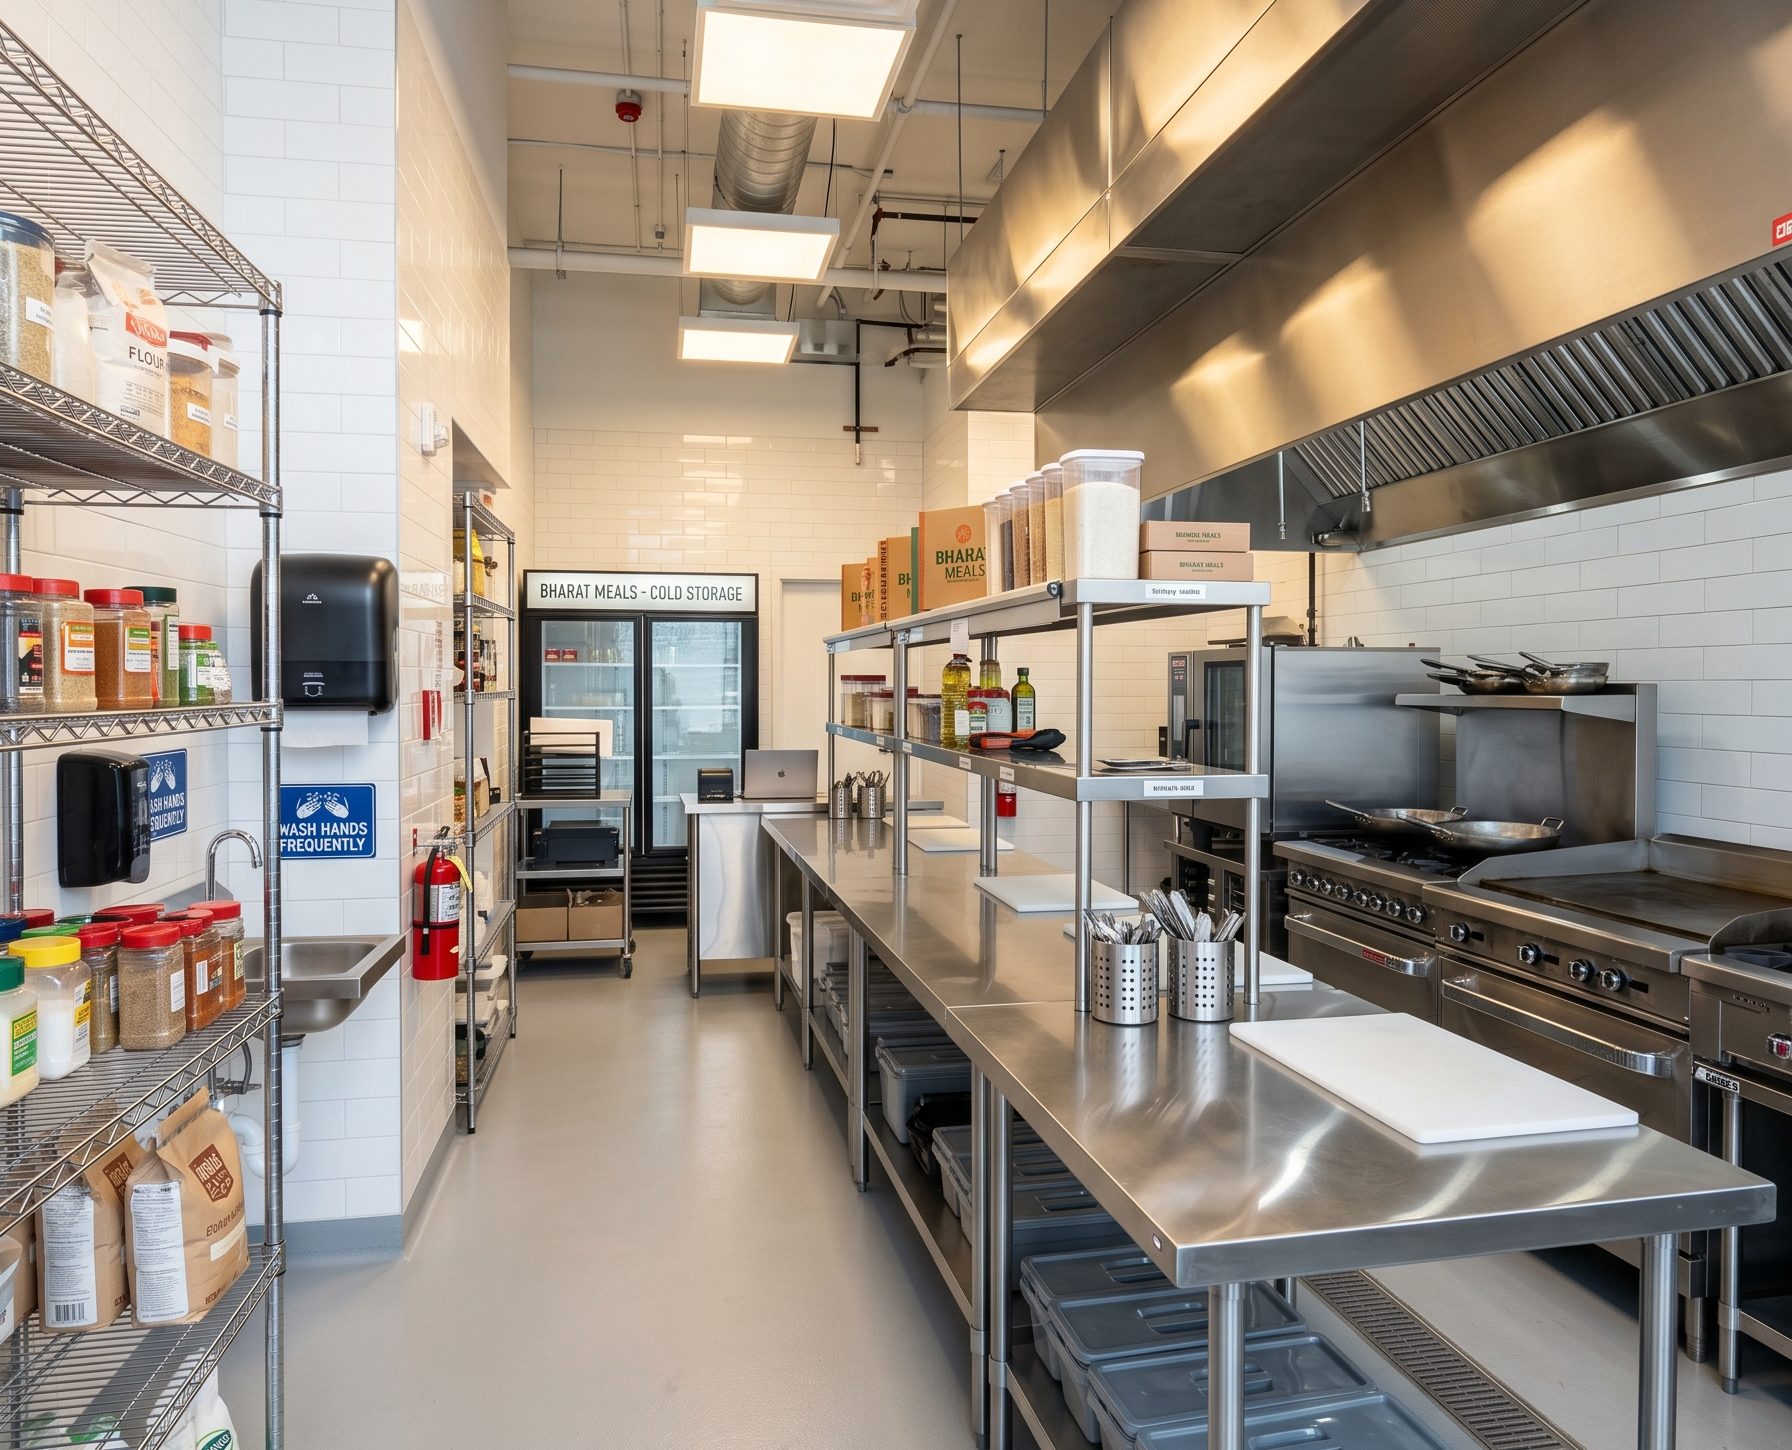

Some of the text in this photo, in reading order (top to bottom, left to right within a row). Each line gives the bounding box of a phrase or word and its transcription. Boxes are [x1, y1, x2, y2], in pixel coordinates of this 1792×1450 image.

[129, 346, 164, 370] FLOUR
[936, 547, 986, 565] BHARA
[945, 563, 985, 579] MEALS
[540, 583, 590, 599] BHARAT
[595, 584, 638, 600] MEALS
[650, 585, 682, 601] COLD
[686, 586, 742, 602] STORAGE
[150, 792, 185, 814] ASH HANDS
[280, 822, 368, 837] WASH HANDS
[280, 837, 366, 853] FREQUENTLY
